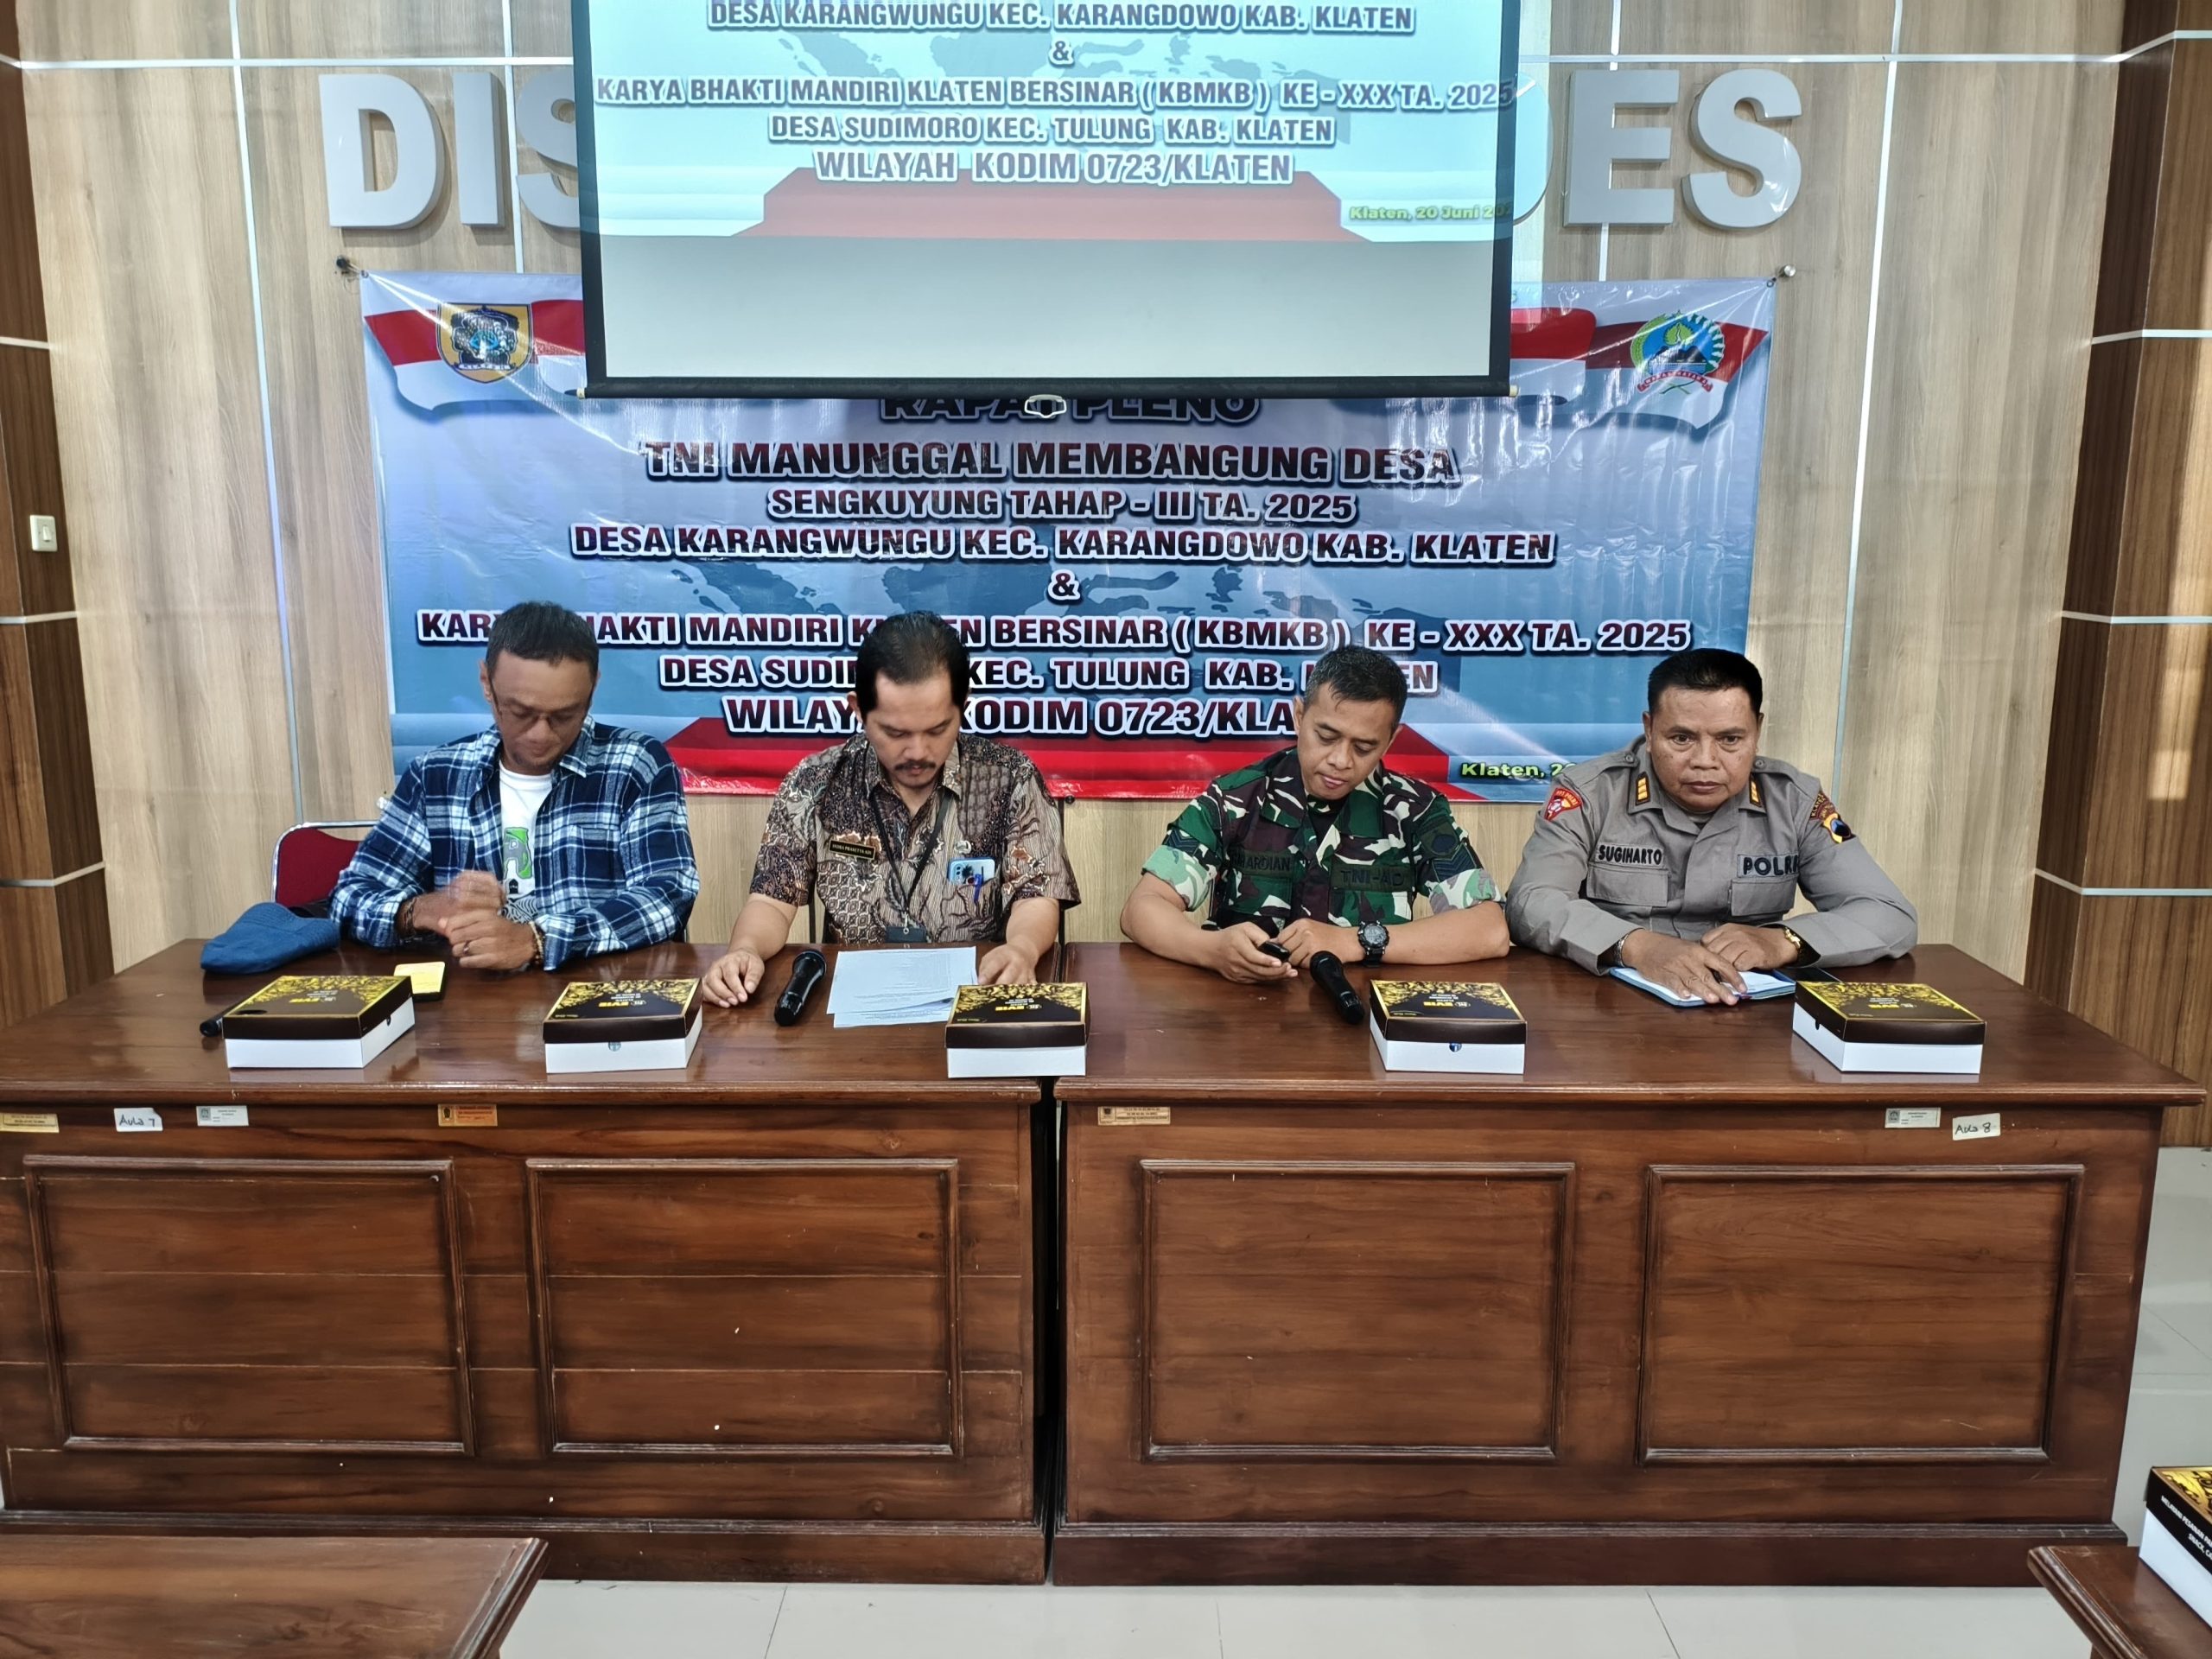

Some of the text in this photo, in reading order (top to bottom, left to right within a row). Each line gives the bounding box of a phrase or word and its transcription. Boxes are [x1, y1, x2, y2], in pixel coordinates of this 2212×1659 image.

[711, 3, 1412, 30] DESA KARANGWUNGU KEC. KARANGDOWO KAB. KLATEN
[1052, 41, 1071, 61] &
[598, 79, 682, 101] KARYA
[693, 79, 780, 102] BHAKTI
[791, 80, 899, 102] MANDIRI
[909, 80, 1001, 102] KLATEN
[1011, 81, 1134, 104] BERSINAR
[1399, 85, 1442, 107] TA.
[1451, 83, 1512, 108] 2025
[772, 116, 1332, 143] DESA SUDIMORO KEC. TULUNG KAB. KLATEN
[817, 151, 1291, 183] WILAYAH KODIM 0723/KLATEN
[1350, 207, 1412, 221] Klaten,
[1415, 207, 1439, 219] 20
[1441, 206, 1479, 219] Juni
[646, 442, 1459, 481] TNI MANUNGGAL MEMBANGUNG DESA
[772, 489, 996, 516] SENGKUYUNG
[1011, 490, 1123, 518] TAHAP
[1160, 492, 1190, 518] III
[1204, 493, 1257, 518] TA.
[1269, 493, 1353, 520] 2025
[575, 526, 1550, 561] DESA KARANGWUNGU KEC. KARANGDOWO KAB. KLATEN
[1053, 572, 1077, 597] &
[422, 613, 501, 638] KAR
[585, 615, 676, 642] AKTI
[690, 617, 838, 643] MANDIRI
[996, 620, 1164, 646] BERSINAR
[1533, 624, 1590, 650] TA.
[1601, 624, 1689, 650] 2025
[666, 658, 752, 684] DESA
[762, 659, 855, 684] SUDI
[1055, 662, 1186, 688] TULUNG
[1206, 664, 1293, 690] KAB.
[1461, 763, 1544, 777] Klaten,
[1598, 844, 1662, 865] SUGIHARTO
[119, 1115, 144, 1127] Aula
[1955, 1122, 1992, 1135] Aula 8
